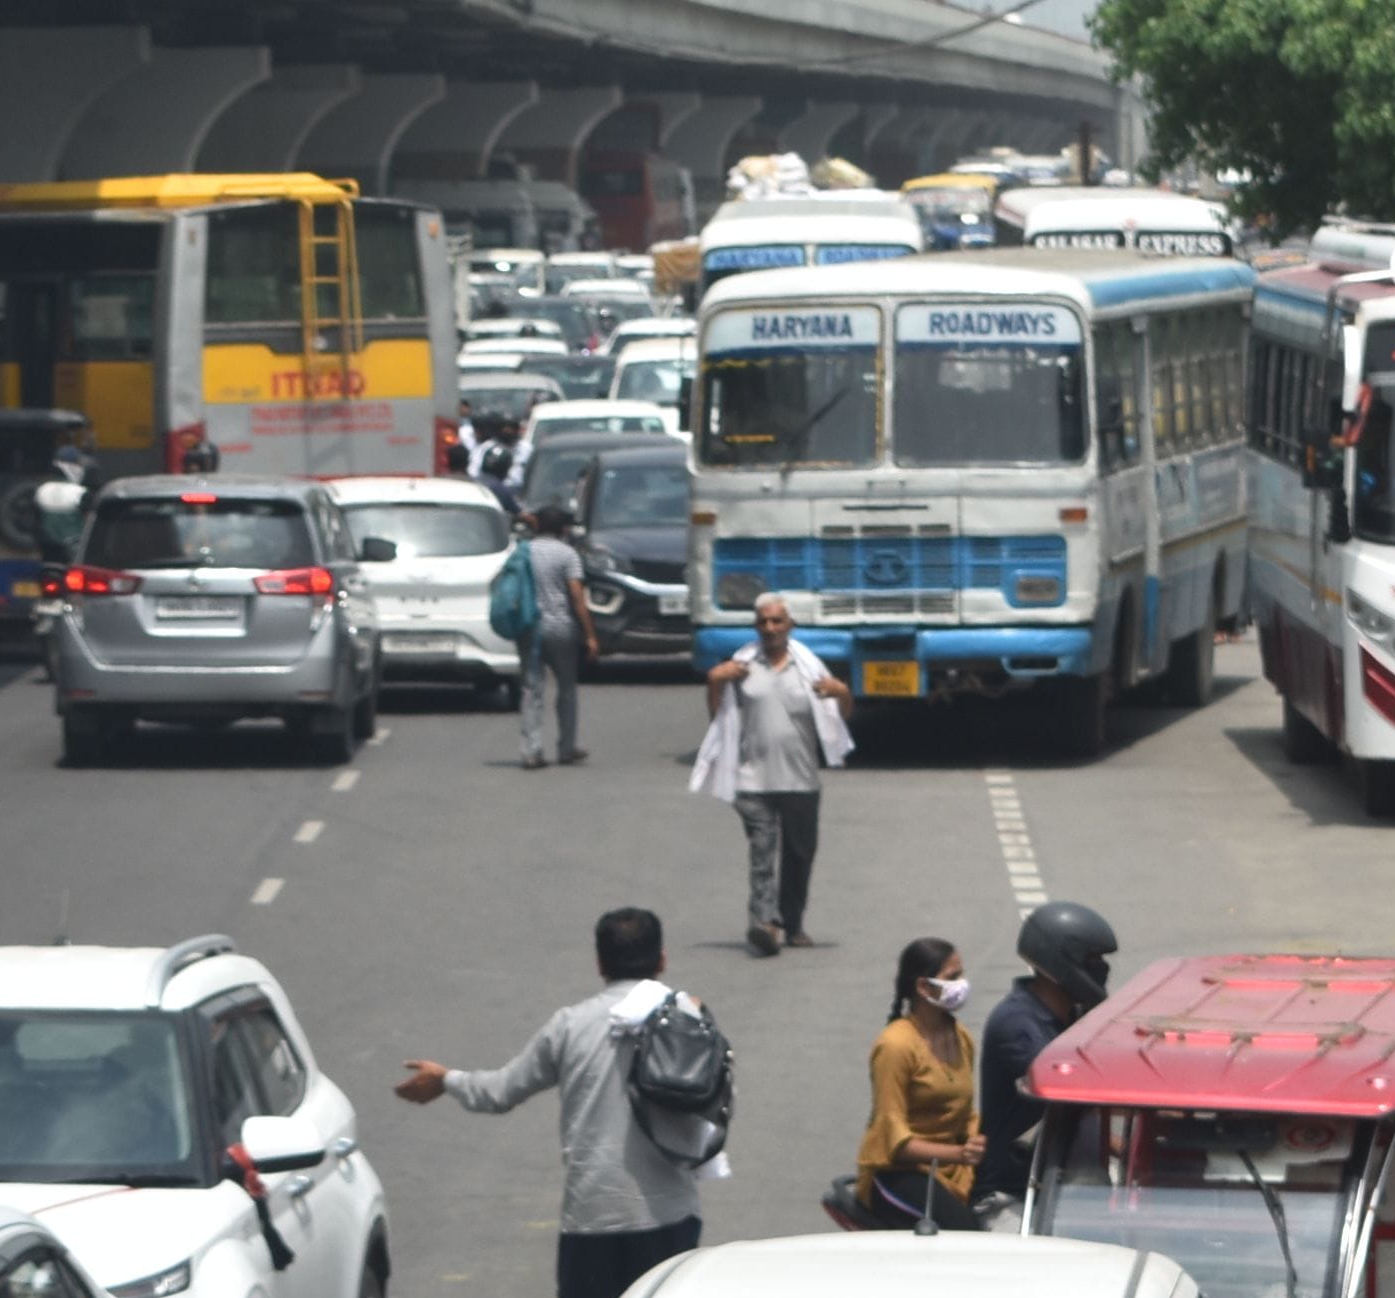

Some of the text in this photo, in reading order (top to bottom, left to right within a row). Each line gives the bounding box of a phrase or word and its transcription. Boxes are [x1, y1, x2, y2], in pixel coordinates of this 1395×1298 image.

[1138, 233, 1225, 255] EXPRESS
[752, 311, 1056, 341] HARYANA ROADWAYS
